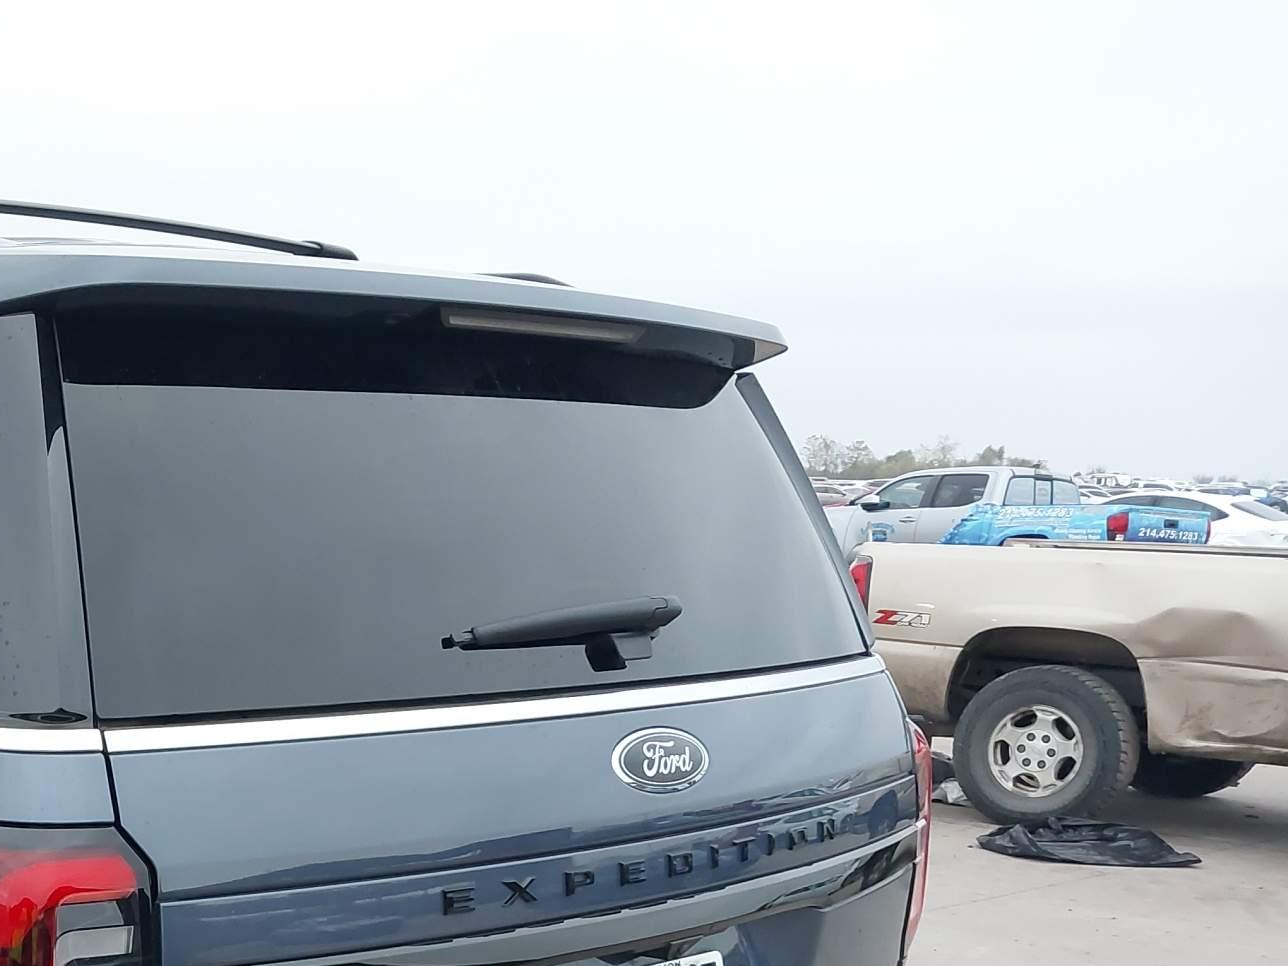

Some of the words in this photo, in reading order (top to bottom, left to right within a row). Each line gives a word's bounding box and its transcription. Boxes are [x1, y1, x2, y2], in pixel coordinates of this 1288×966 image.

[1138, 528, 1199, 540] 214.475.1283
[872, 609, 931, 627] Z71
[642, 740, 693, 777] Ford
[442, 817, 837, 917] EXPEDITION
